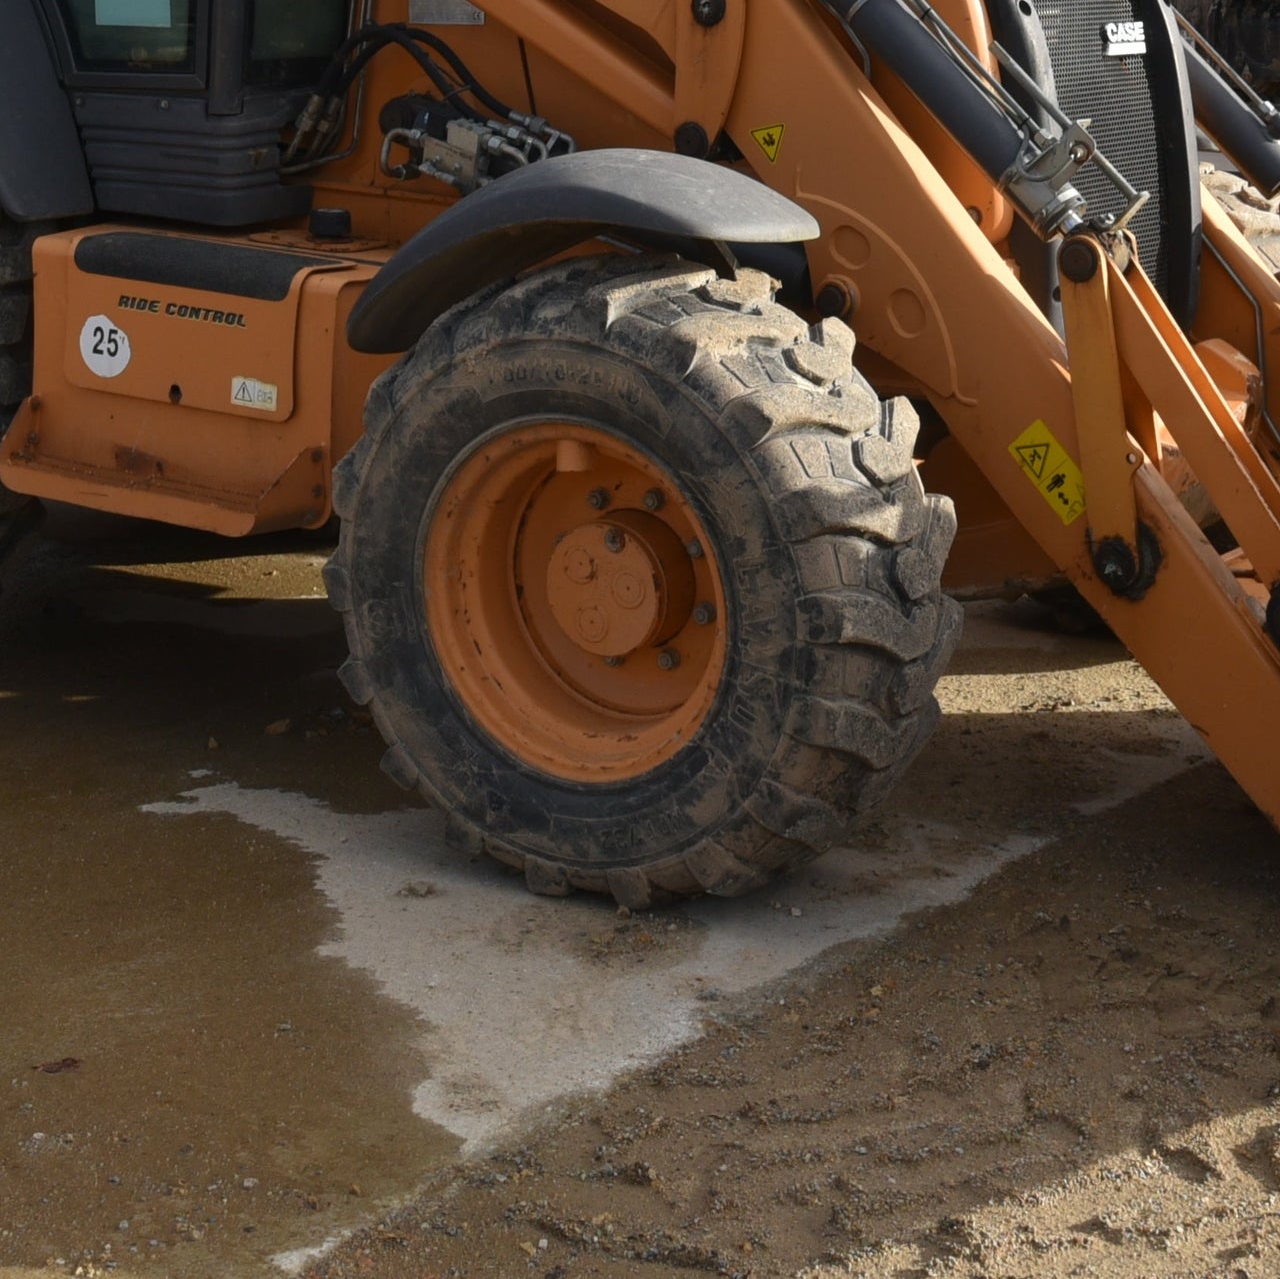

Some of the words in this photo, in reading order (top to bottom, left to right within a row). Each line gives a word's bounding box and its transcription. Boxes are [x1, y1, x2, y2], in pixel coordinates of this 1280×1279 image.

[1105, 21, 1145, 43] CASE
[118, 294, 161, 313] RIDE
[165, 302, 247, 328] CONTROL
[92, 325, 119, 358] 25
